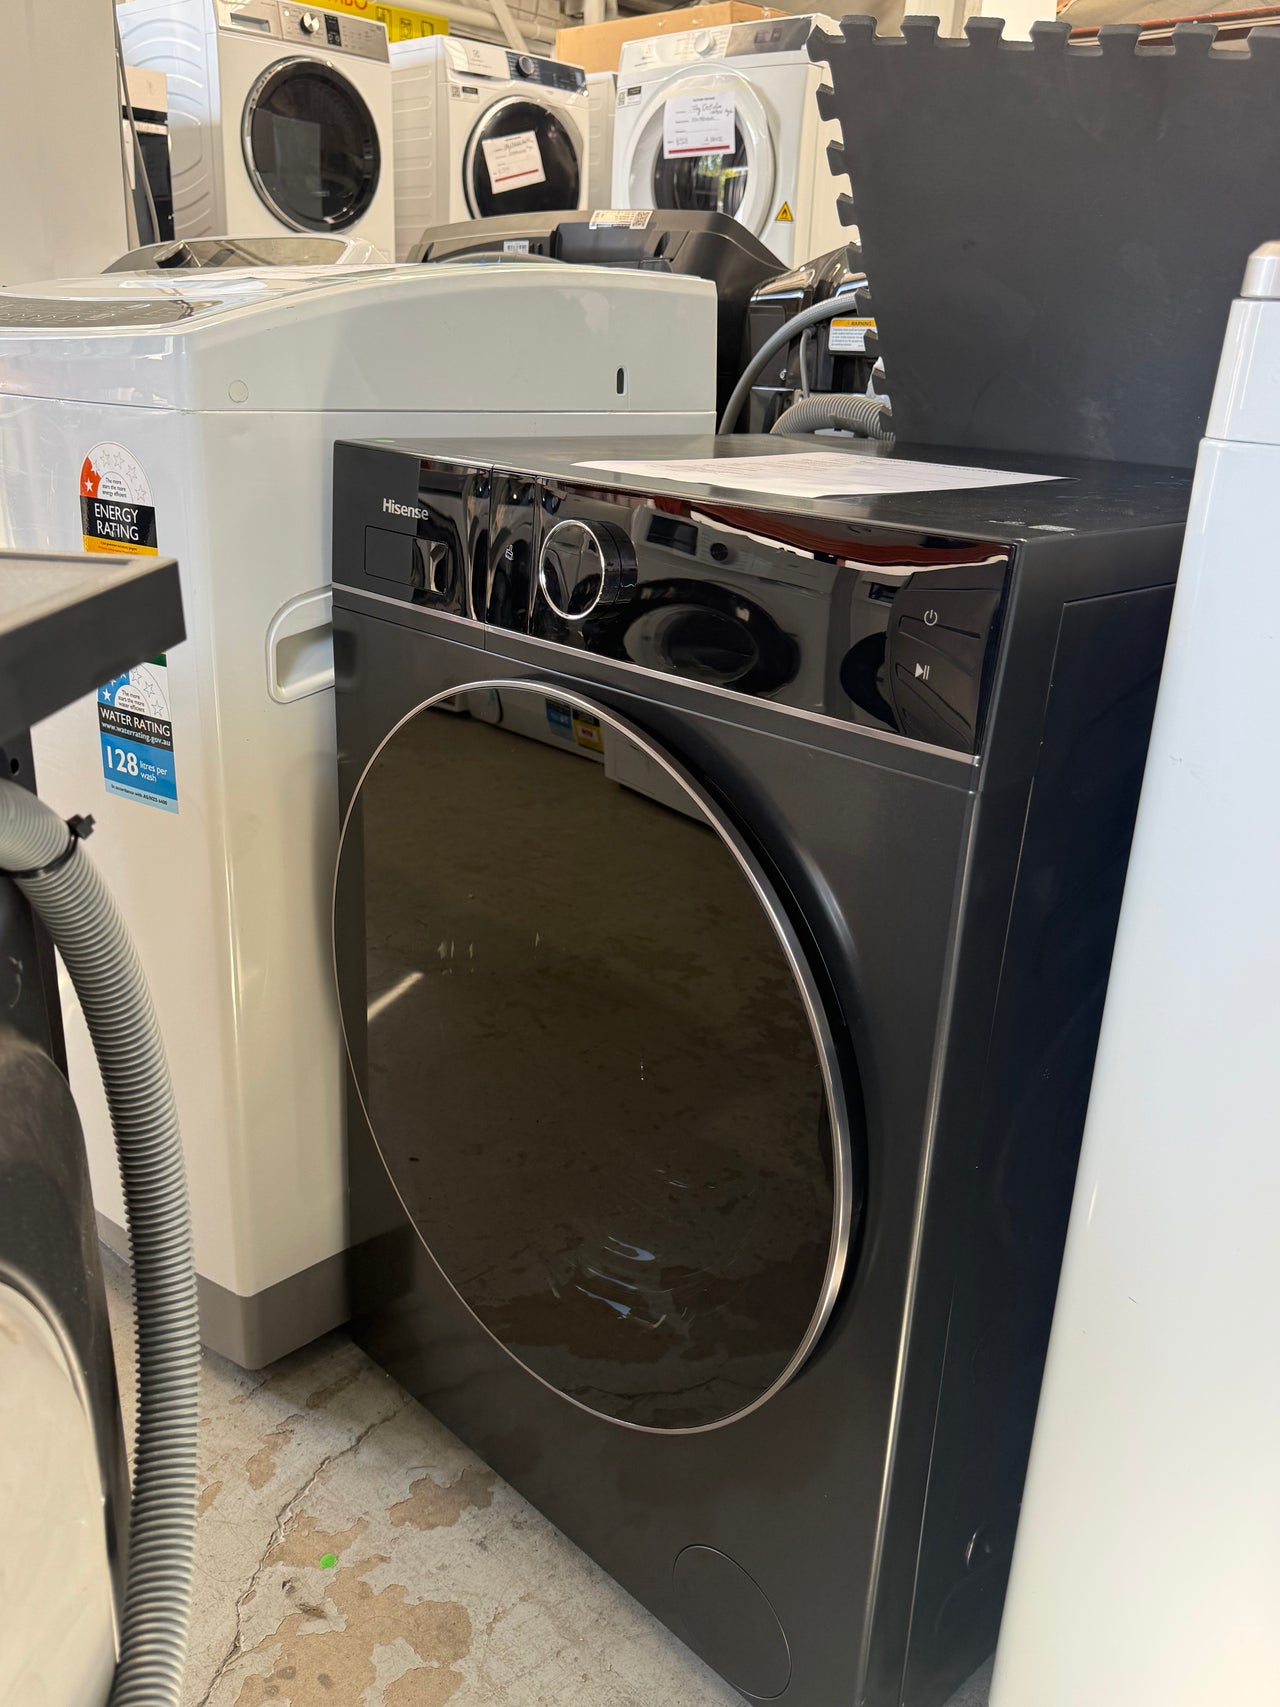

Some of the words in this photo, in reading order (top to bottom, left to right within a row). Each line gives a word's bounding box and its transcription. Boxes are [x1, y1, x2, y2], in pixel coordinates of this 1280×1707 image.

[94, 502, 138, 524] ENERGY
[382, 498, 428, 520] Hisense
[96, 520, 139, 541] RATING
[122, 689, 130, 697] The
[100, 706, 132, 727] WATER
[134, 716, 171, 737] RATING
[102, 722, 171, 746] www.waterrating.gov.au
[107, 745, 138, 776] 128
[140, 760, 156, 772] litres
[156, 767, 168, 776] per
[141, 772, 156, 782] wash
